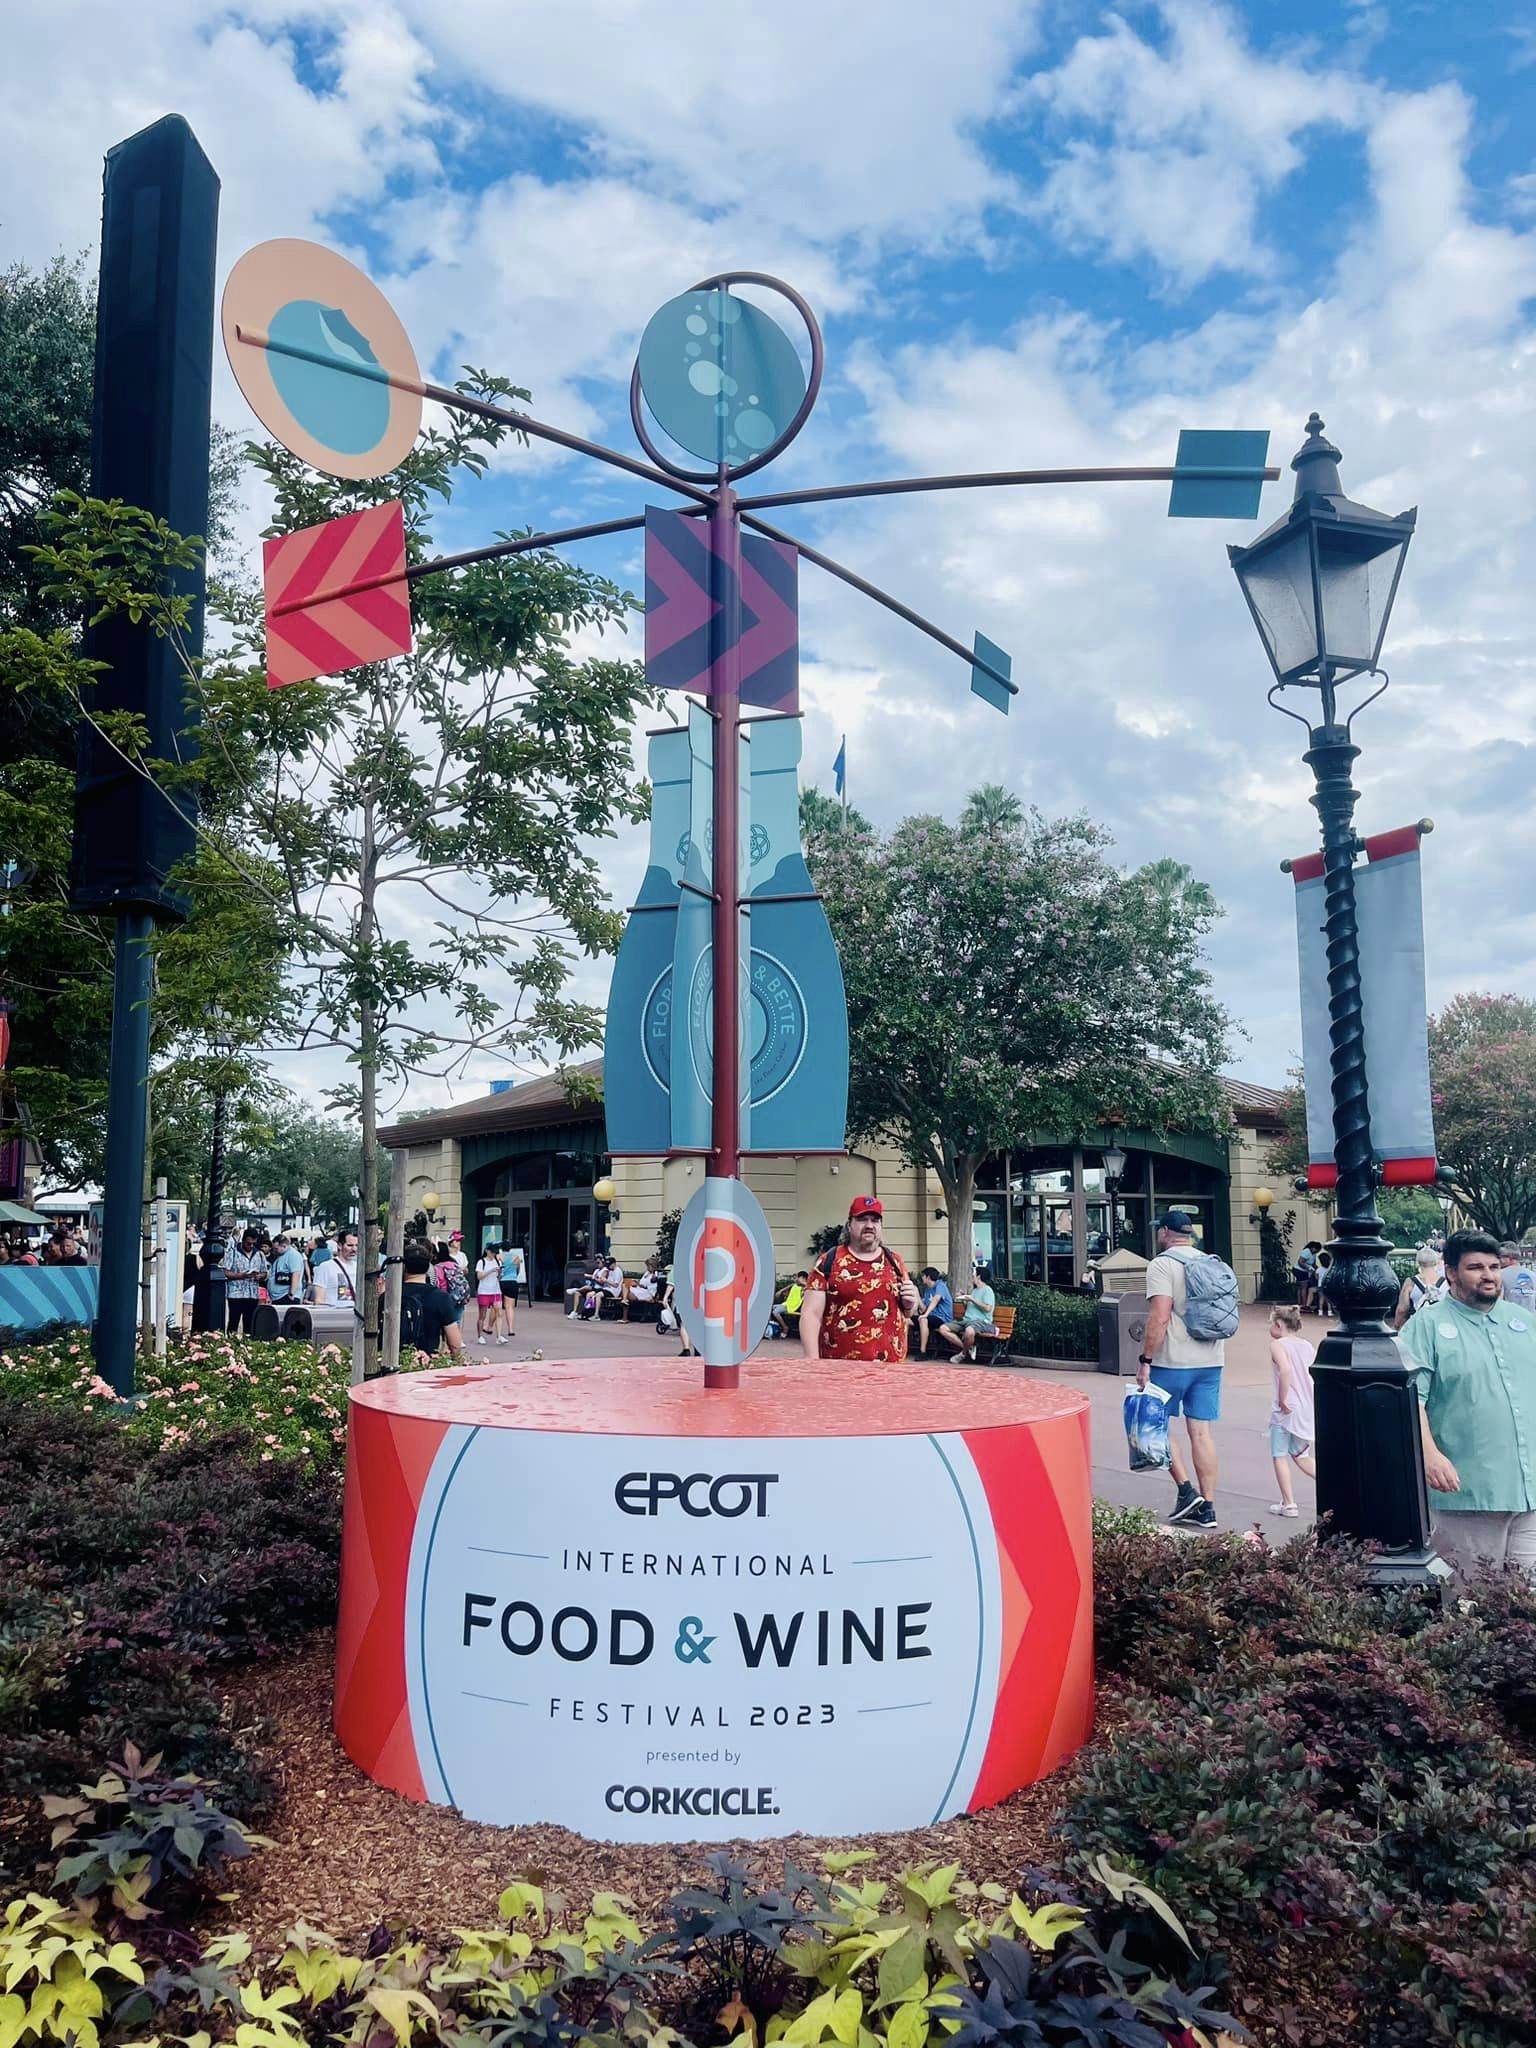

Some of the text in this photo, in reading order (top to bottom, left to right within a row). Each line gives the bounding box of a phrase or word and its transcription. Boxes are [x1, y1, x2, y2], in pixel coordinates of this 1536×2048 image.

[754, 965, 767, 983] &
[767, 977, 796, 1035] BETTE
[615, 1472, 779, 1517] EPCOT
[564, 1549, 833, 1576] INTERNATIONAL
[463, 1592, 932, 1668] FOOD & WINE
[551, 1698, 834, 1726] FESTIVAL 2023
[647, 1749, 740, 1765] presented by
